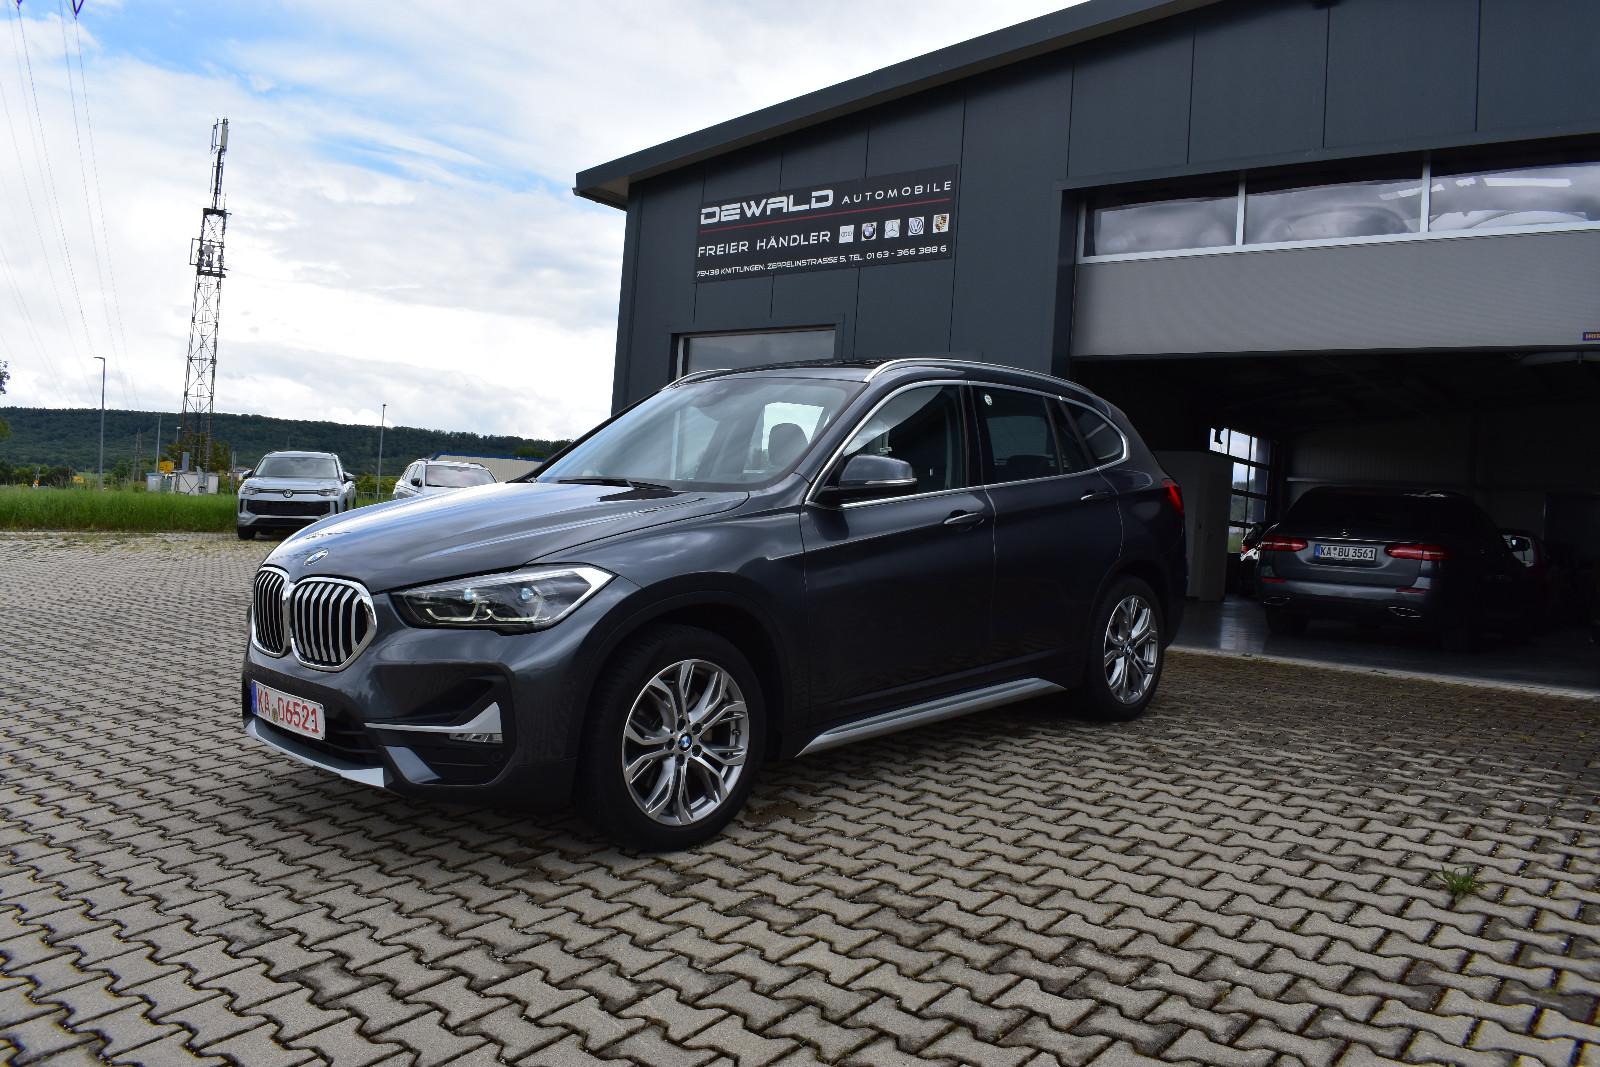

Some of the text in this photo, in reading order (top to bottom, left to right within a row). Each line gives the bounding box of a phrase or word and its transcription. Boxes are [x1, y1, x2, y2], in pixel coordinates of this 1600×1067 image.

[700, 181, 952, 225] DEWALD AUTOMOBILE
[697, 231, 831, 258] FREIER HÄNDLER
[767, 256, 838, 270] ZEPPELINSTRASSE
[1320, 546, 1374, 559] KA BU 3561
[257, 688, 271, 717] KA
